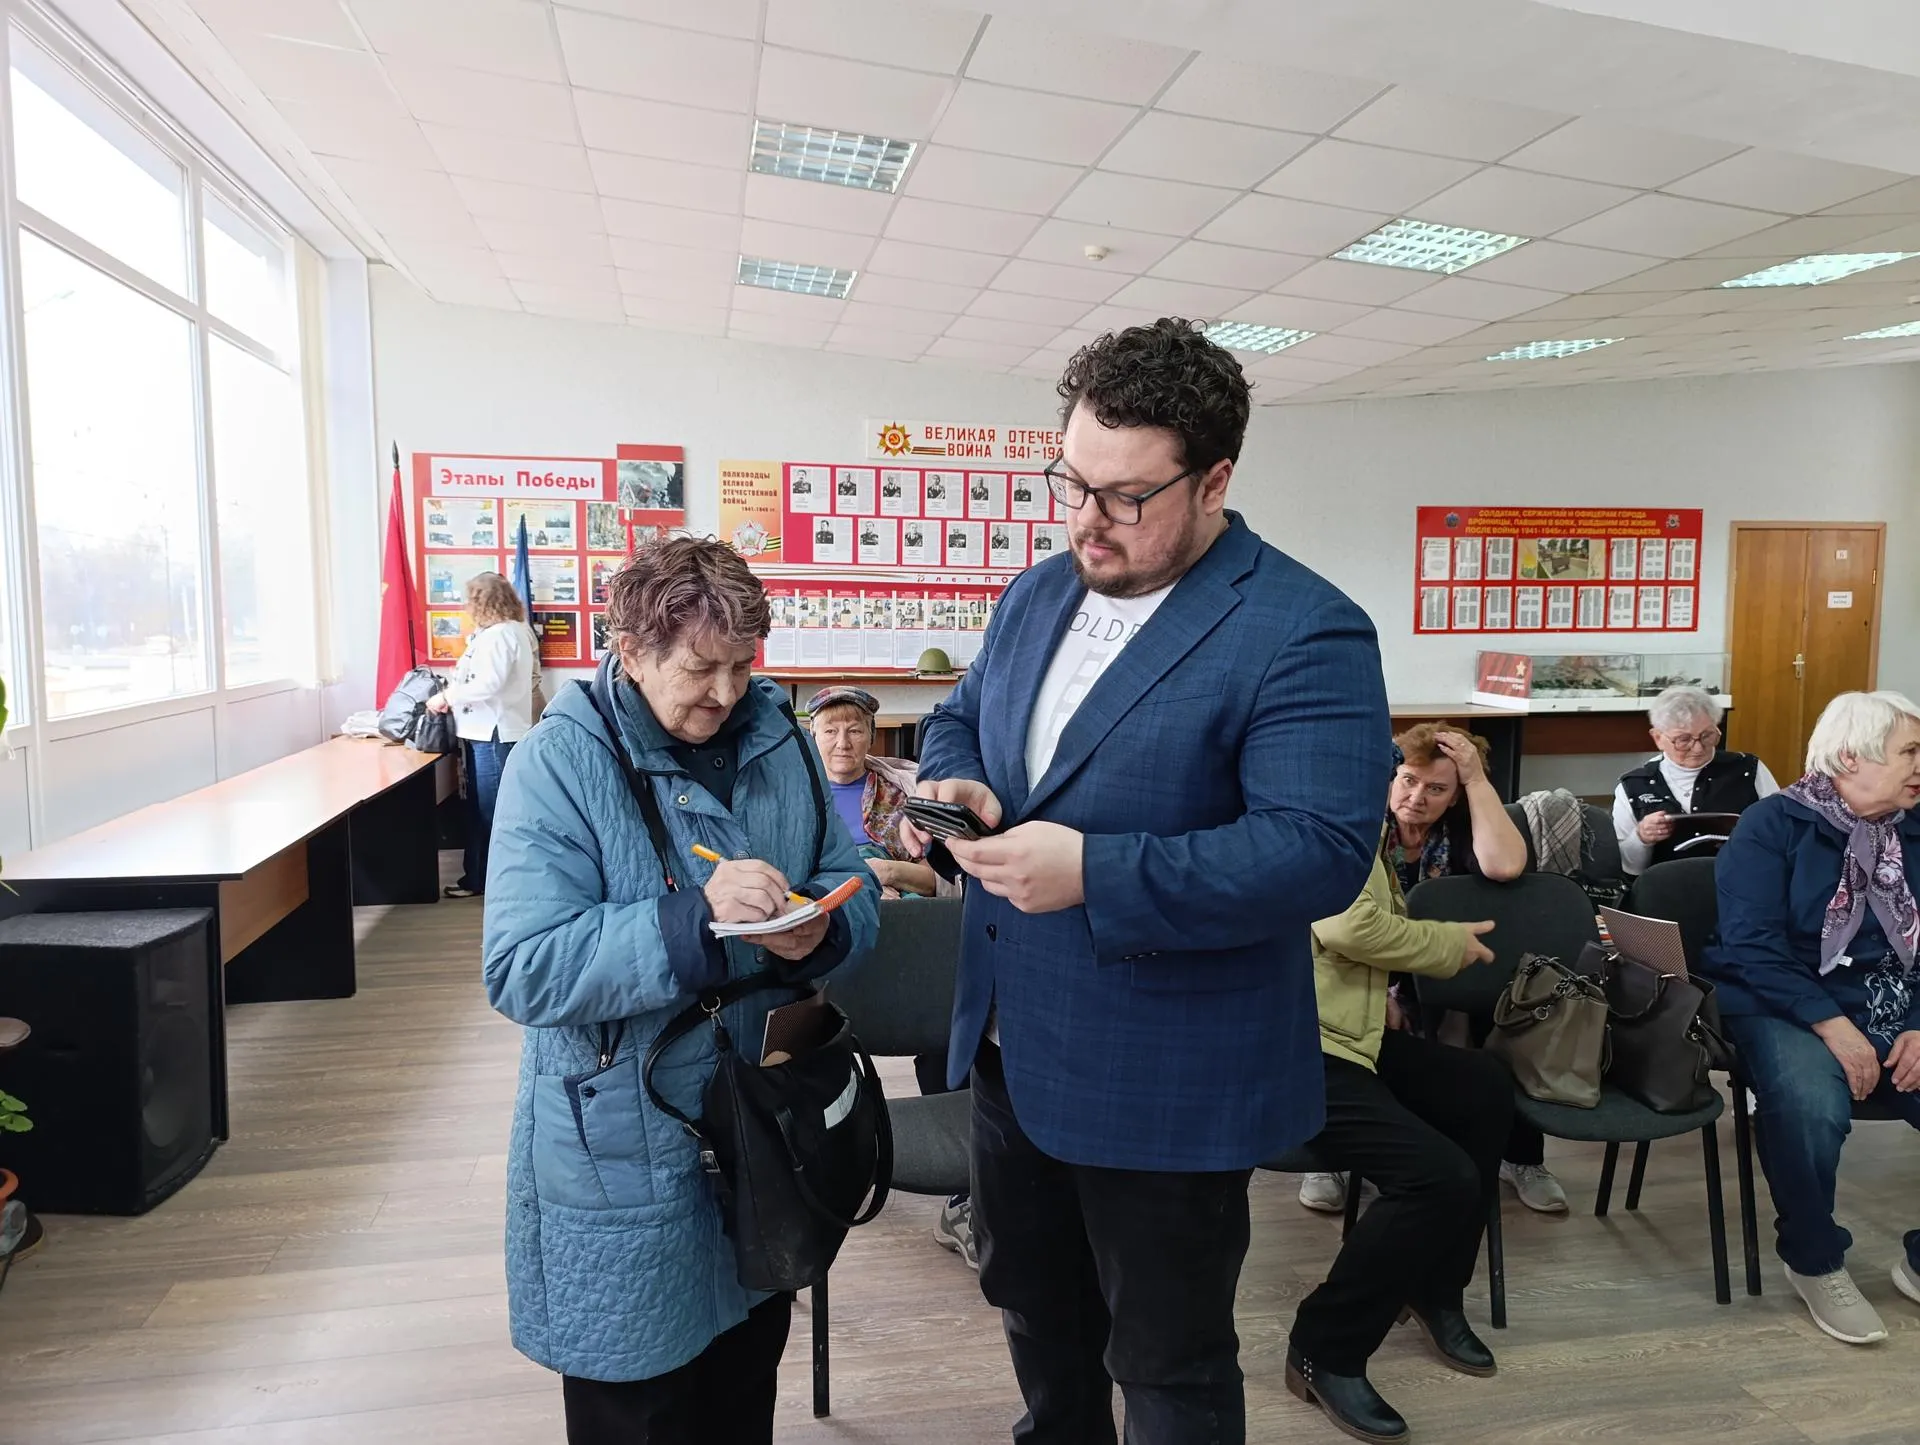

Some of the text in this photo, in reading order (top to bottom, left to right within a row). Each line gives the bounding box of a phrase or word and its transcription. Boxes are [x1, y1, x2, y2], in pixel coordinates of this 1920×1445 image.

[925, 426, 996, 442] ВЕЛИКАЯ
[947, 442, 992, 458] ВОЙНА
[440, 468, 595, 490] Этапы Победы
[722, 471, 771, 479] ПОЛКОВОДЦЫ
[722, 489, 778, 497] ОТЕЧЕСТВЕННОЙ
[1492, 526, 1520, 534] ВОЙНЫ
